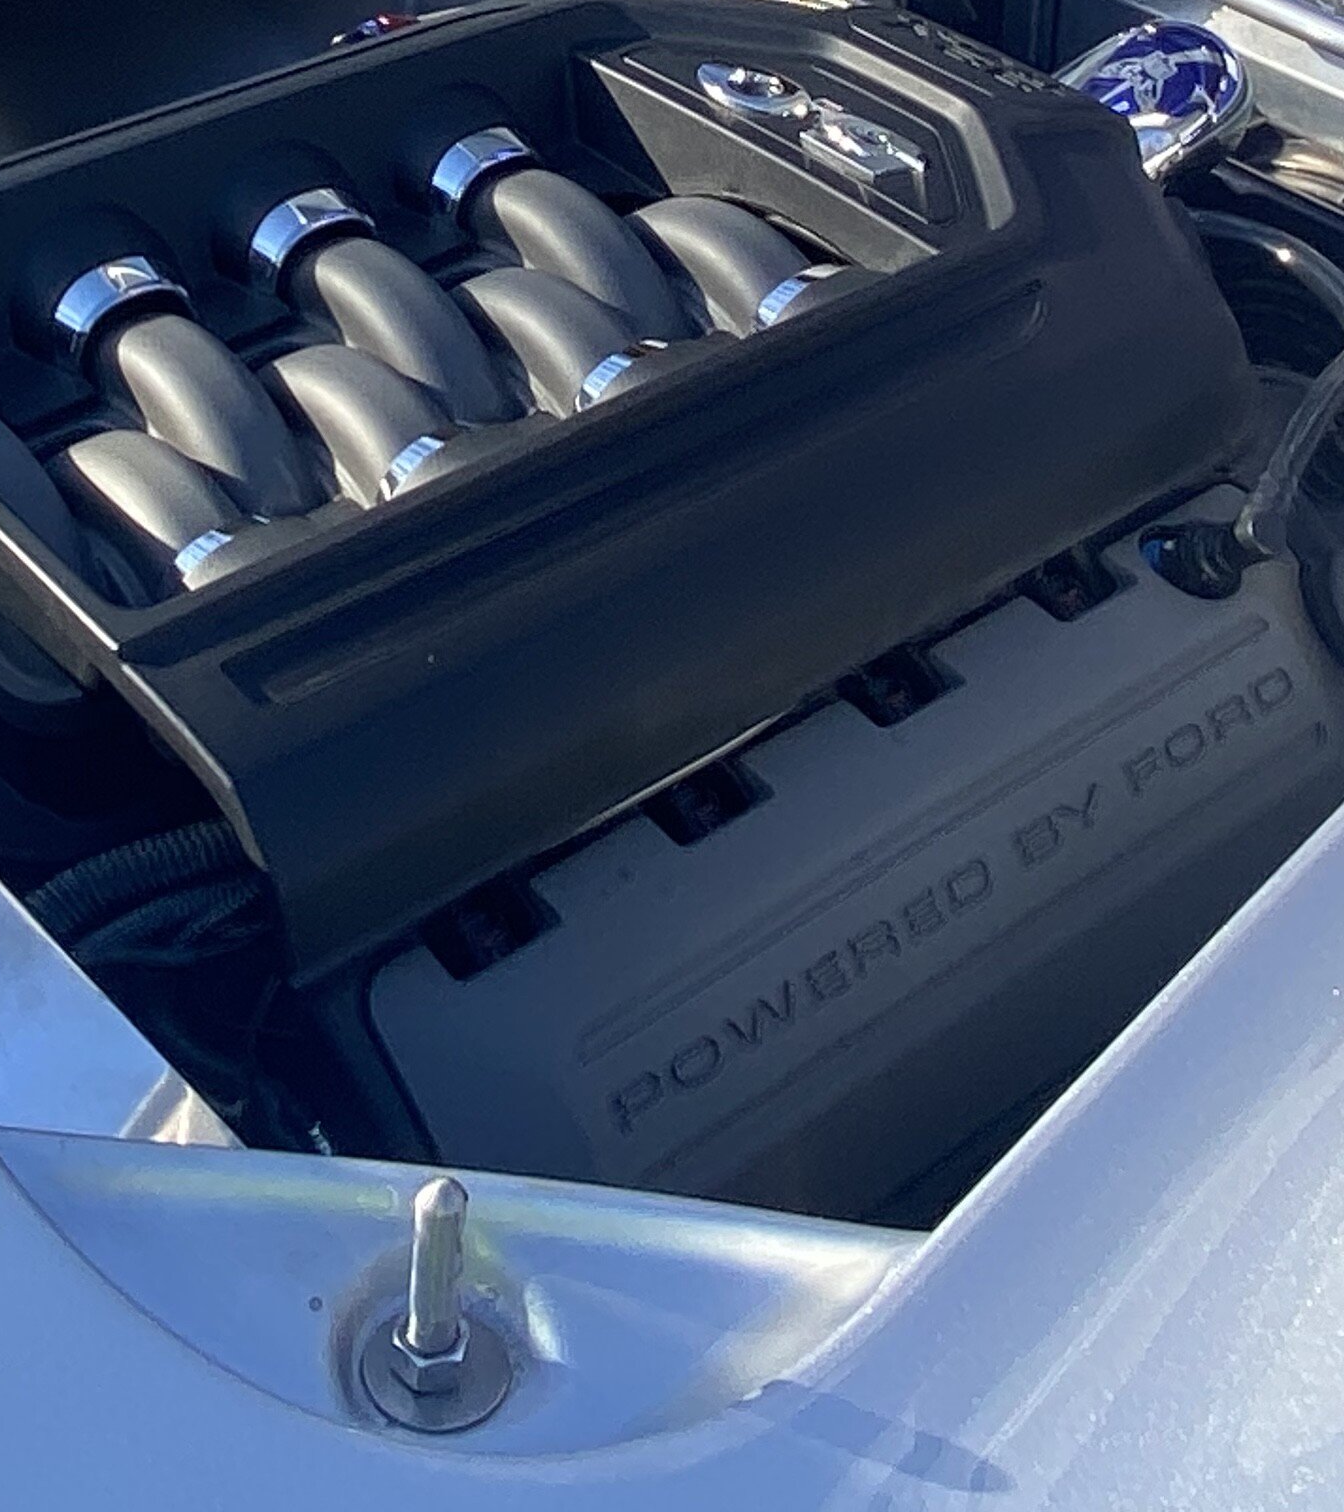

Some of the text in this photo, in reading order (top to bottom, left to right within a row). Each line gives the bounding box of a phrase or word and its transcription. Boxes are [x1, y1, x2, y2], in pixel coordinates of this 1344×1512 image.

[605, 667, 1293, 1135] POWERED BY FORD
